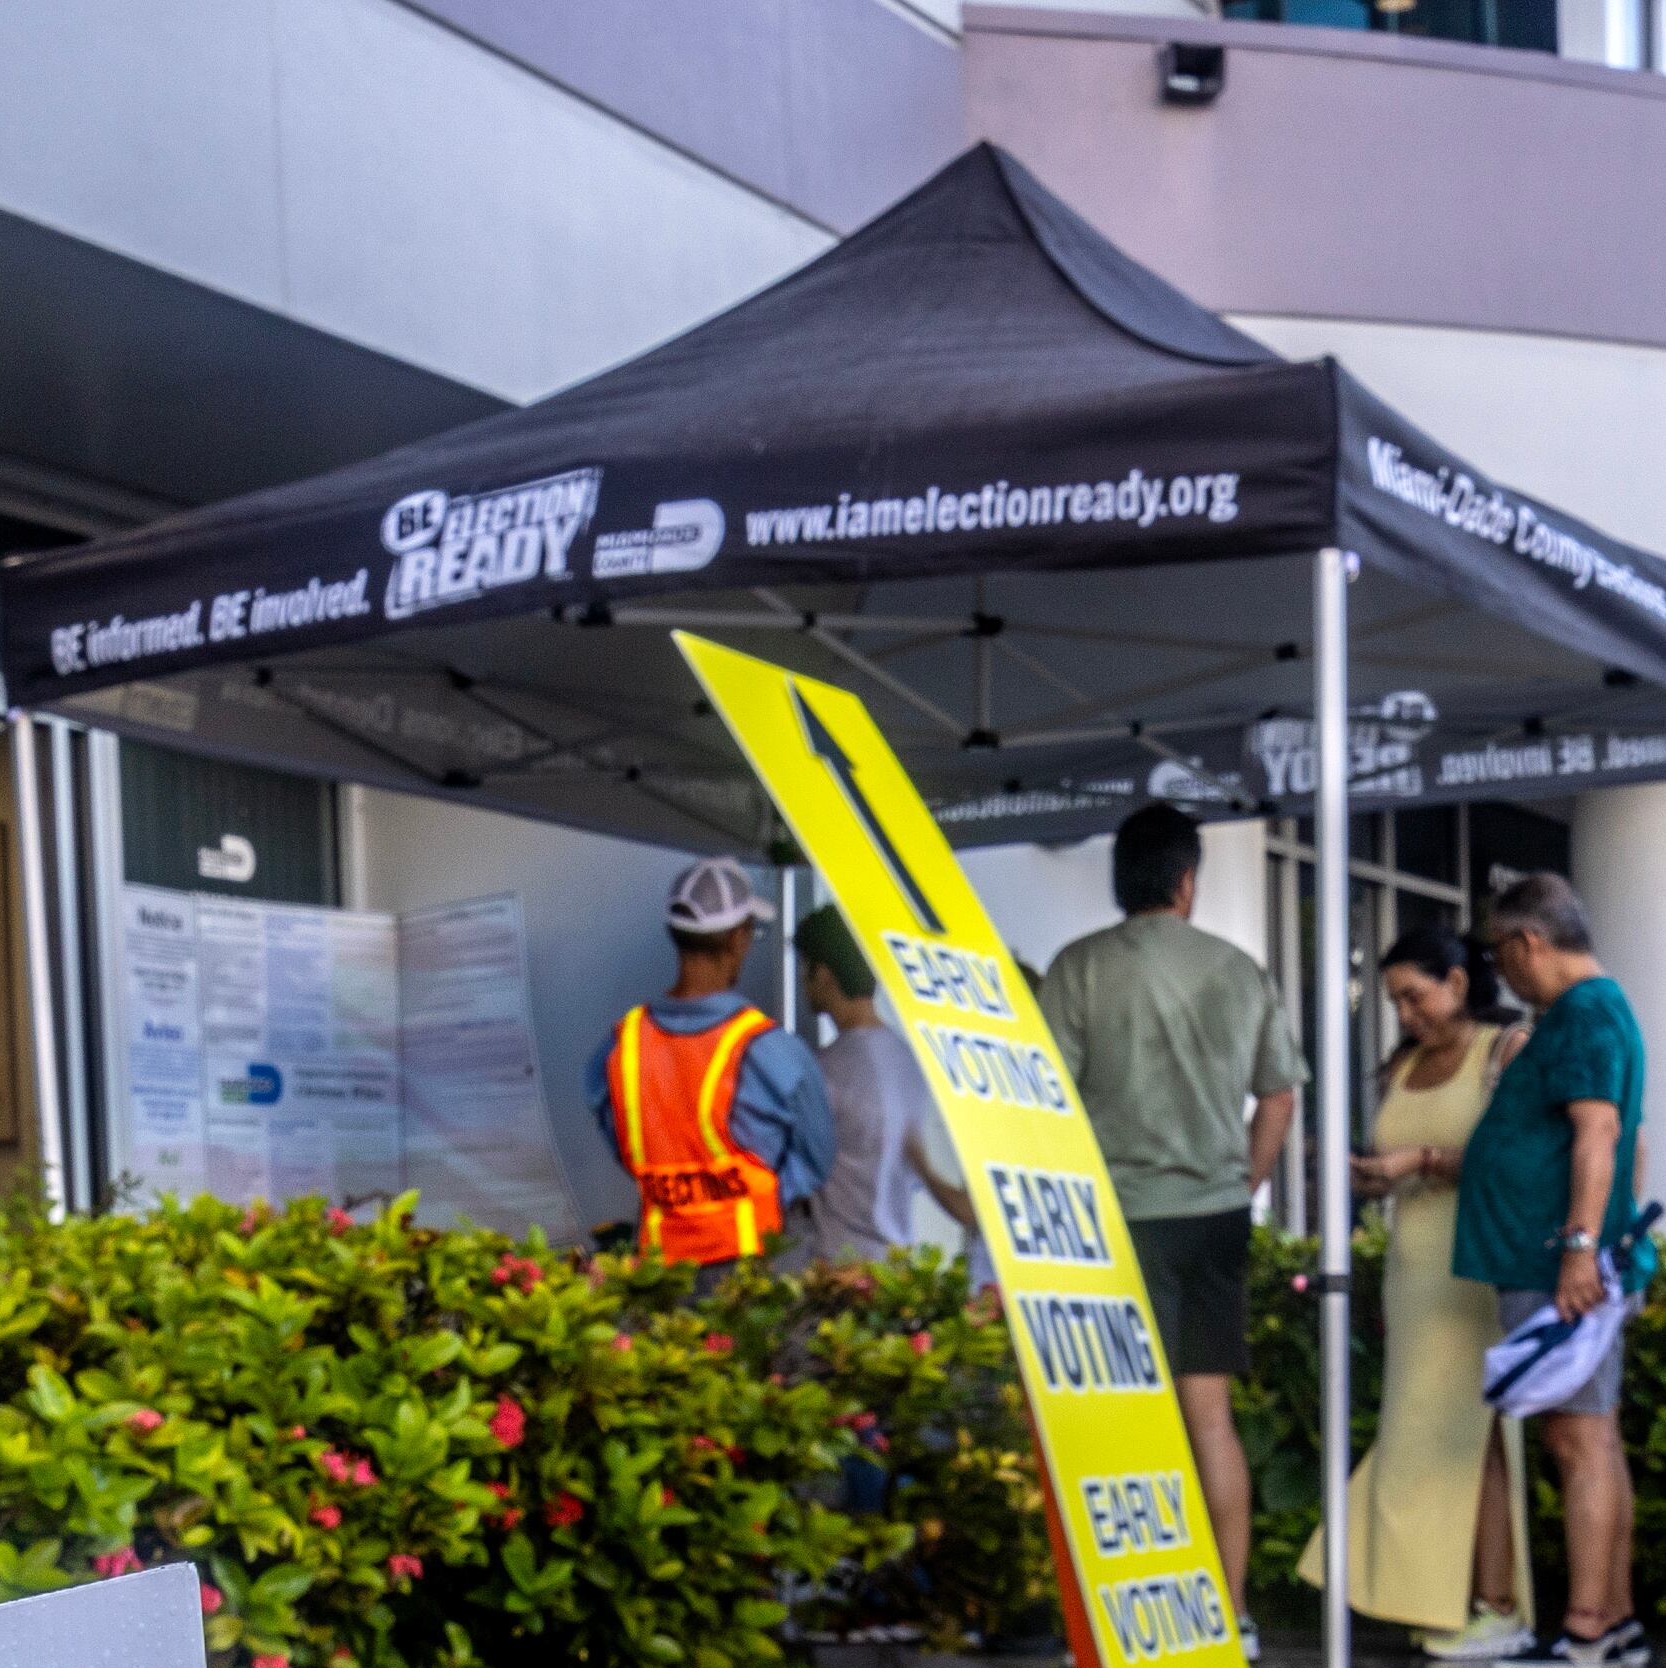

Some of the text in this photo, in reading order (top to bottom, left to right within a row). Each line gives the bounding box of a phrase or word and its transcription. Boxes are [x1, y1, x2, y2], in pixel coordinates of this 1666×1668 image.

[443, 476, 597, 542] ELECTION
[745, 467, 1240, 547] www.iamelectionready.org
[395, 518, 585, 602] READY
[50, 567, 371, 677] BE informed. BE involved.
[884, 931, 1016, 1020] EARLY
[916, 1023, 1072, 1115] VOTING
[986, 1164, 1113, 1267] EARLY
[1017, 1293, 1163, 1391] VOTING
[1080, 1472, 1191, 1557] EARLY
[1098, 1568, 1229, 1663] VOTING
